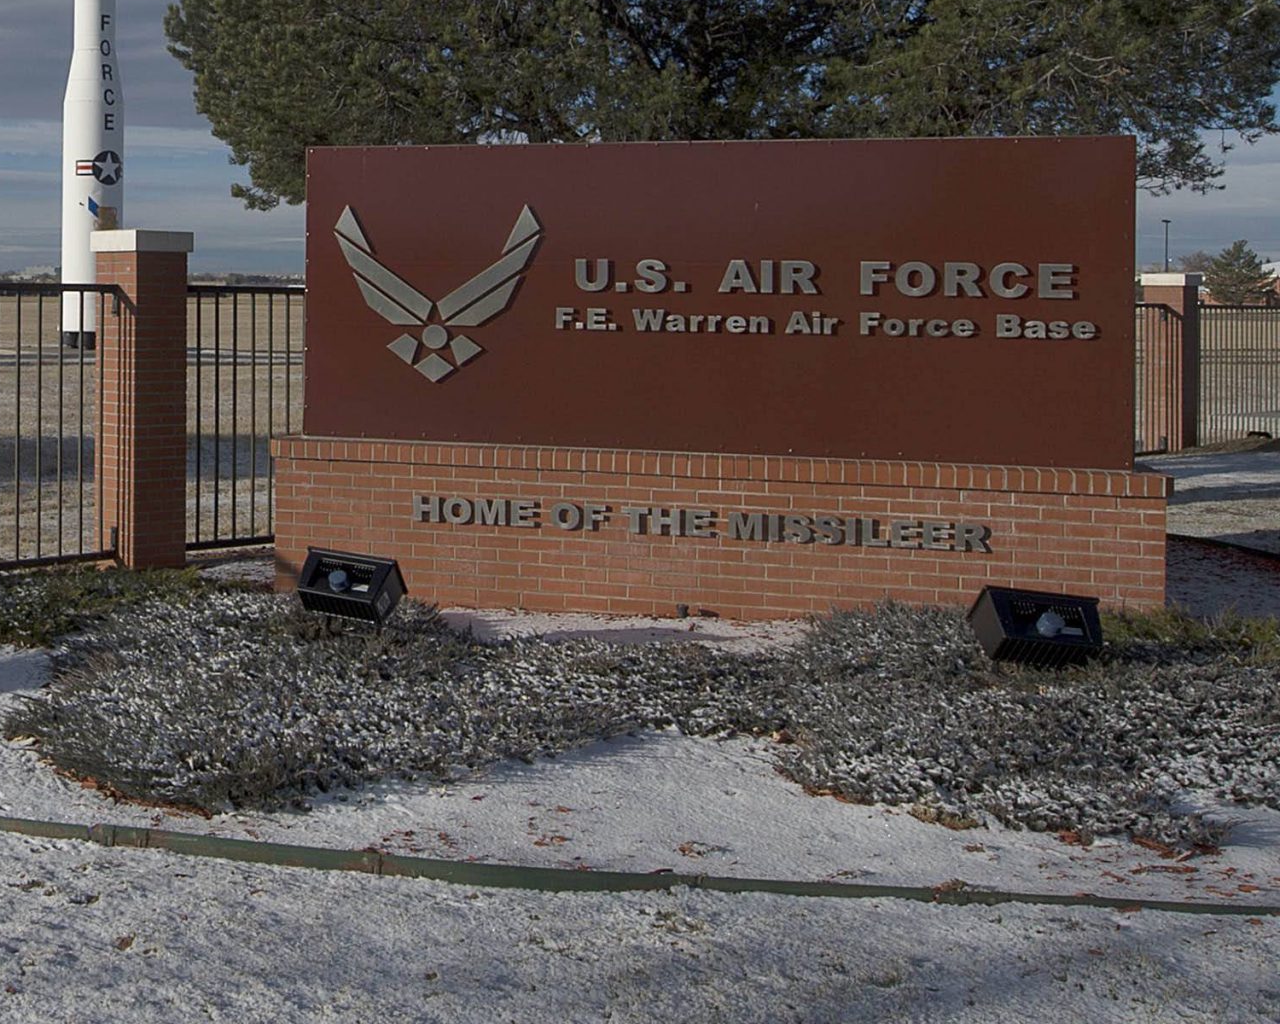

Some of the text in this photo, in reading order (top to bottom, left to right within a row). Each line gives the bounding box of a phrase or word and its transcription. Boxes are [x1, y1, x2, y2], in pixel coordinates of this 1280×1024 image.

[100, 14, 115, 131] FORCE
[575, 258, 1074, 299] U.S. AIR FORCE
[555, 307, 1097, 340] F.E. Warren Air Force Base
[412, 495, 989, 553] HOME OF THE MISSILEER
